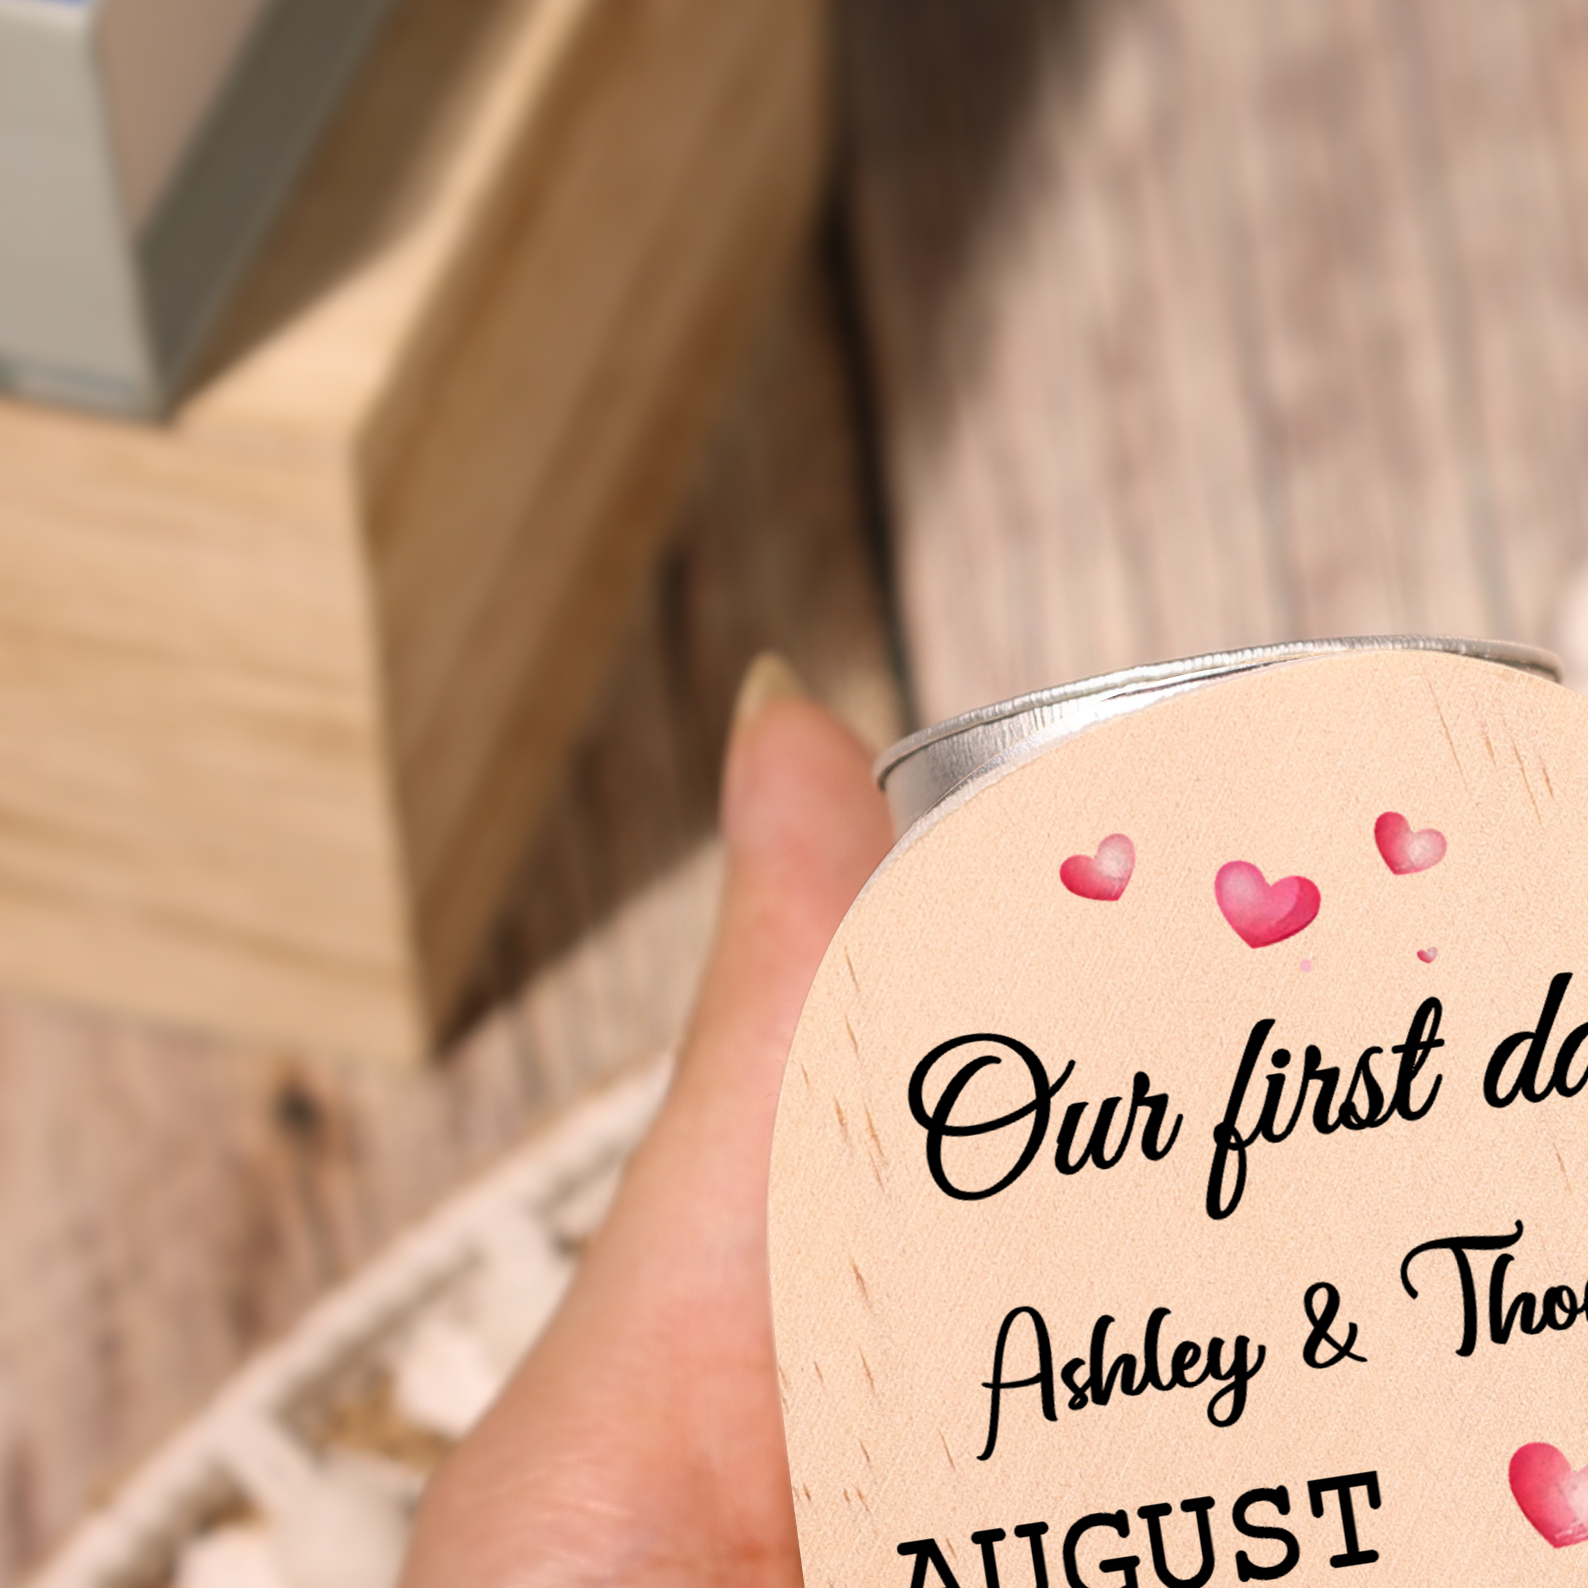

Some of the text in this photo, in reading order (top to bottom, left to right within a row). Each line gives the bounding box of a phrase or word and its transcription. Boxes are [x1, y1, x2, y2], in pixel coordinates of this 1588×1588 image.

[906, 1031, 1185, 1202] Our
[1204, 994, 1446, 1221] first
[974, 1304, 1267, 1462] Ashley
[1300, 1279, 1369, 1370] &
